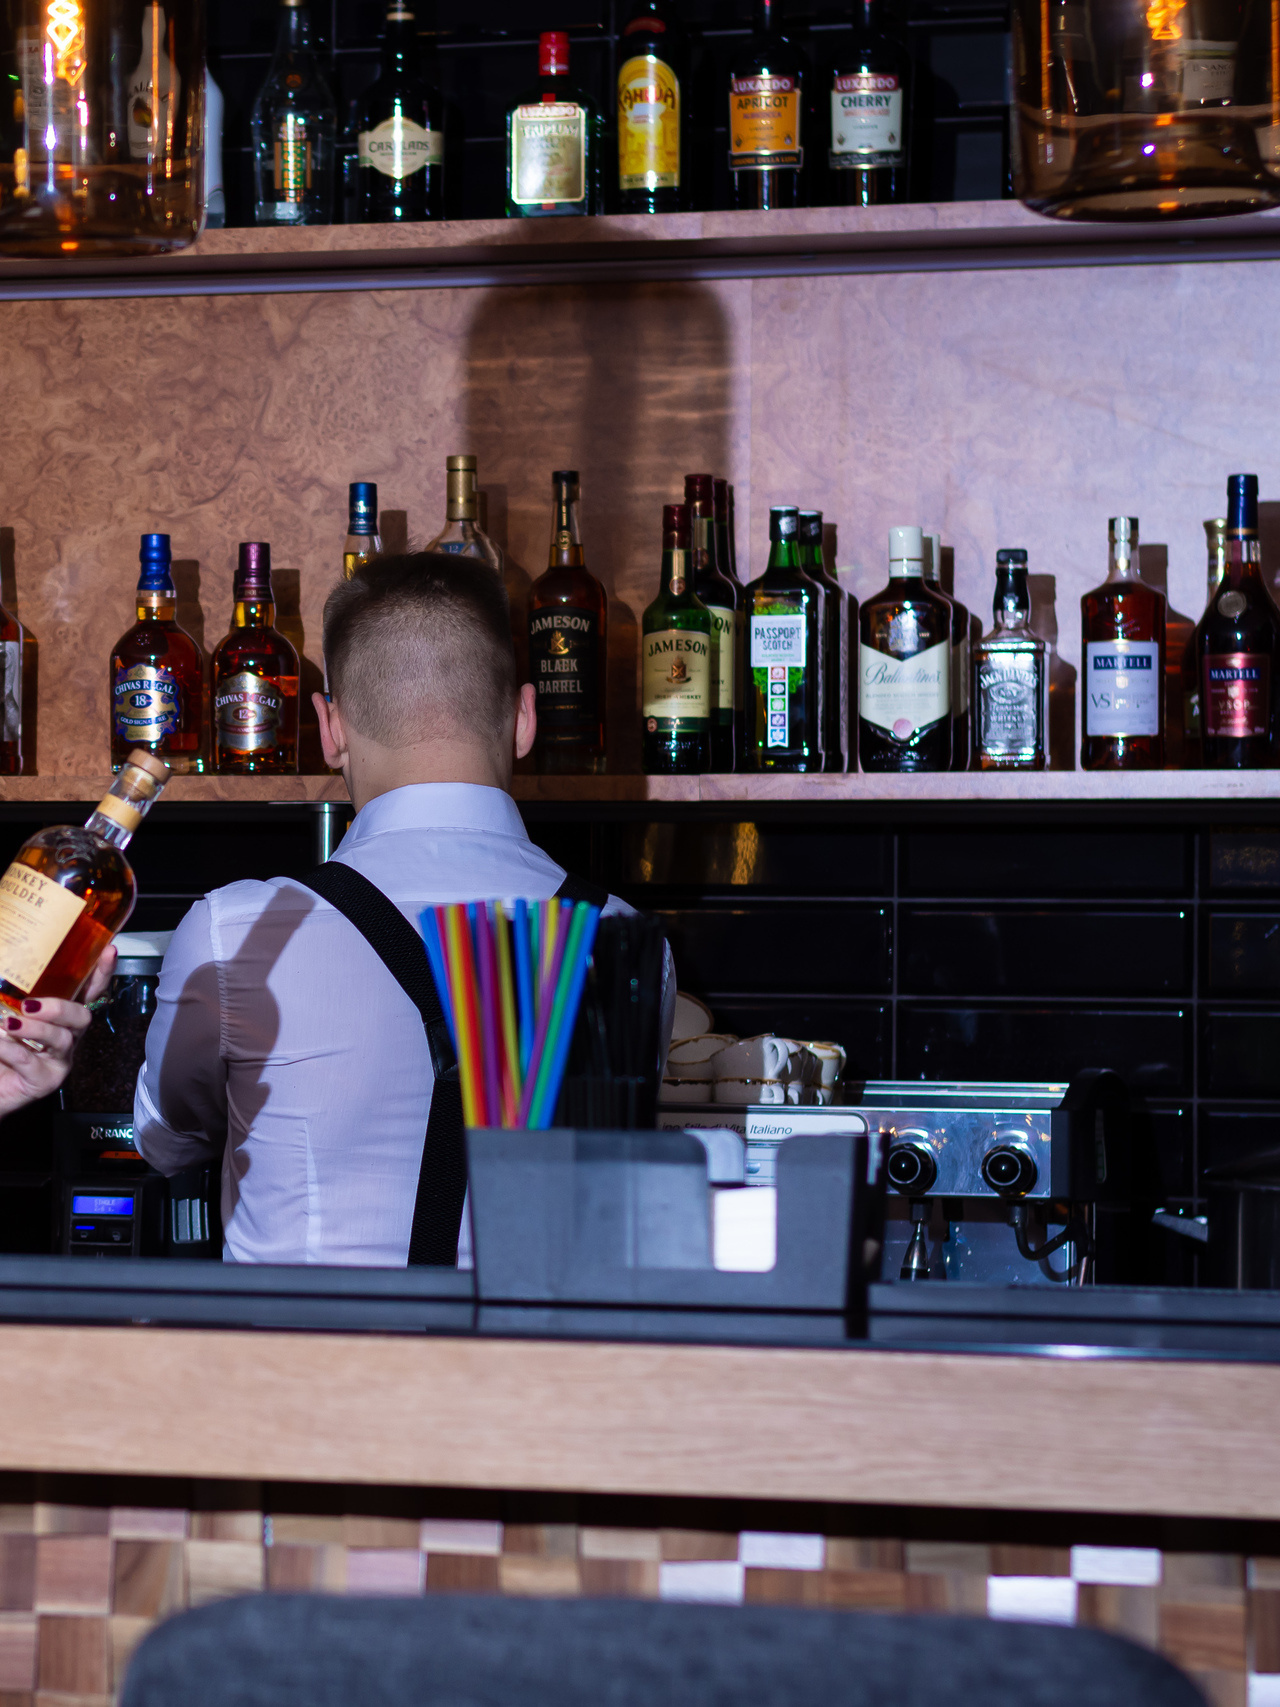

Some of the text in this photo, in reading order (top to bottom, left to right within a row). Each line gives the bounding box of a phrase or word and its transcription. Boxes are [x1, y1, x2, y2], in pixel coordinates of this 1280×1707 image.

[734, 79, 791, 93] LUXARDO
[836, 77, 895, 90] LUXARDO
[737, 96, 789, 110] APRICOT
[841, 94, 891, 108] CHERRY
[368, 141, 430, 153] CARLANS
[530, 615, 591, 636] JAMESON
[754, 626, 802, 640] PASSPORT
[648, 639, 708, 658] JAMESON
[762, 640, 793, 651] SCOTCH
[540, 658, 578, 673] BLACK
[1210, 669, 1258, 680] MARTELL
[115, 681, 141, 696] CHIVAS
[538, 680, 583, 694] BARREL
[134, 694, 147, 707] 18
[215, 693, 277, 709] CHIVAS REGAL
[1091, 693, 1110, 709] VS
[238, 708, 249, 719] 12
[105, 1128, 134, 1139] RANC
[749, 1125, 793, 1135] Italiano
